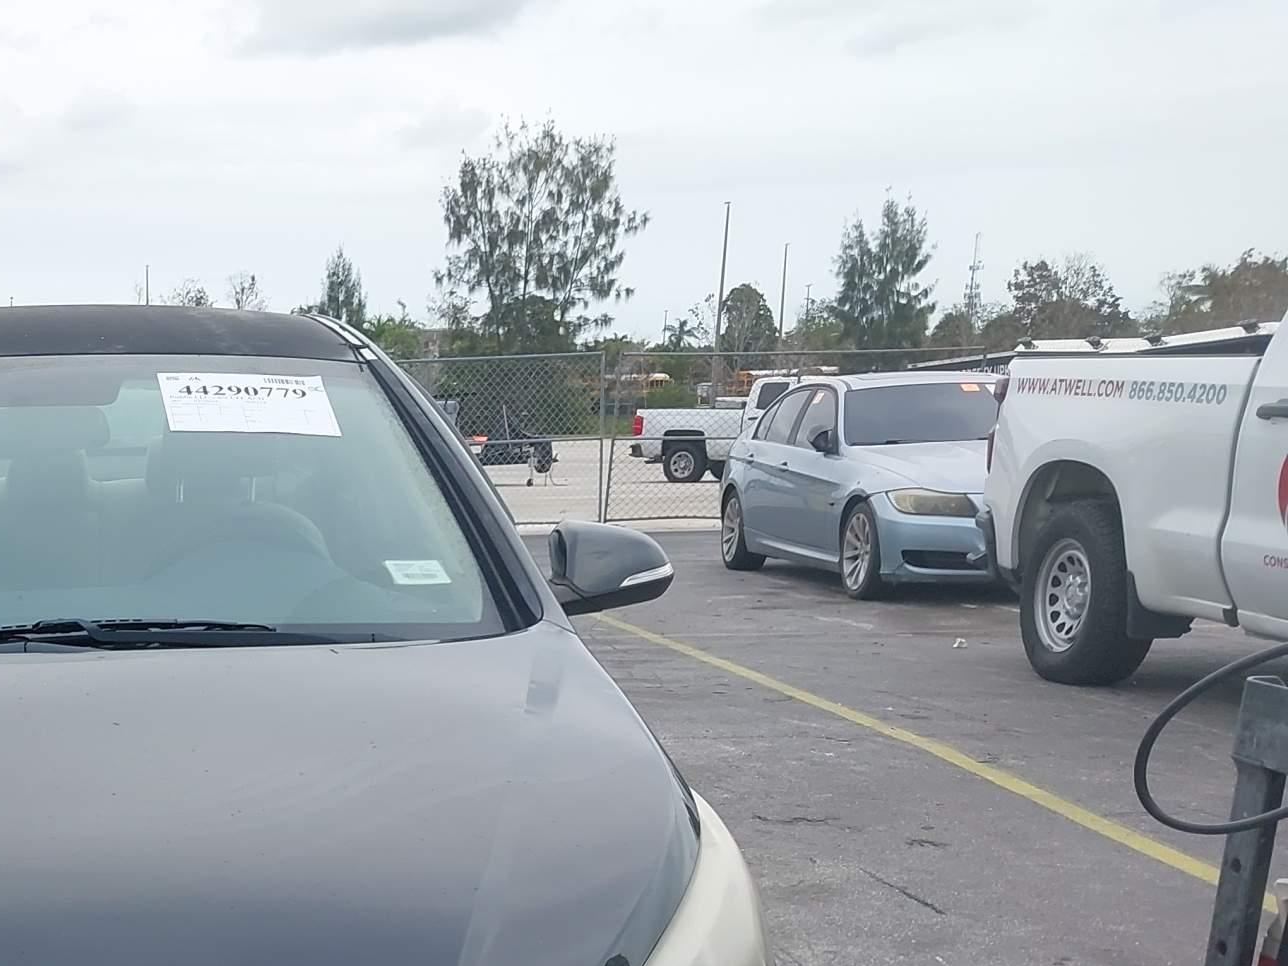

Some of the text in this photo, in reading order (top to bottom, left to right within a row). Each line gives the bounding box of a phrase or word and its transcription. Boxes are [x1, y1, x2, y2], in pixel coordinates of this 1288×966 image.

[178, 384, 307, 399] 44290779
[1016, 377, 1228, 405] WWW.ATWELL.COM 866.850.4200
